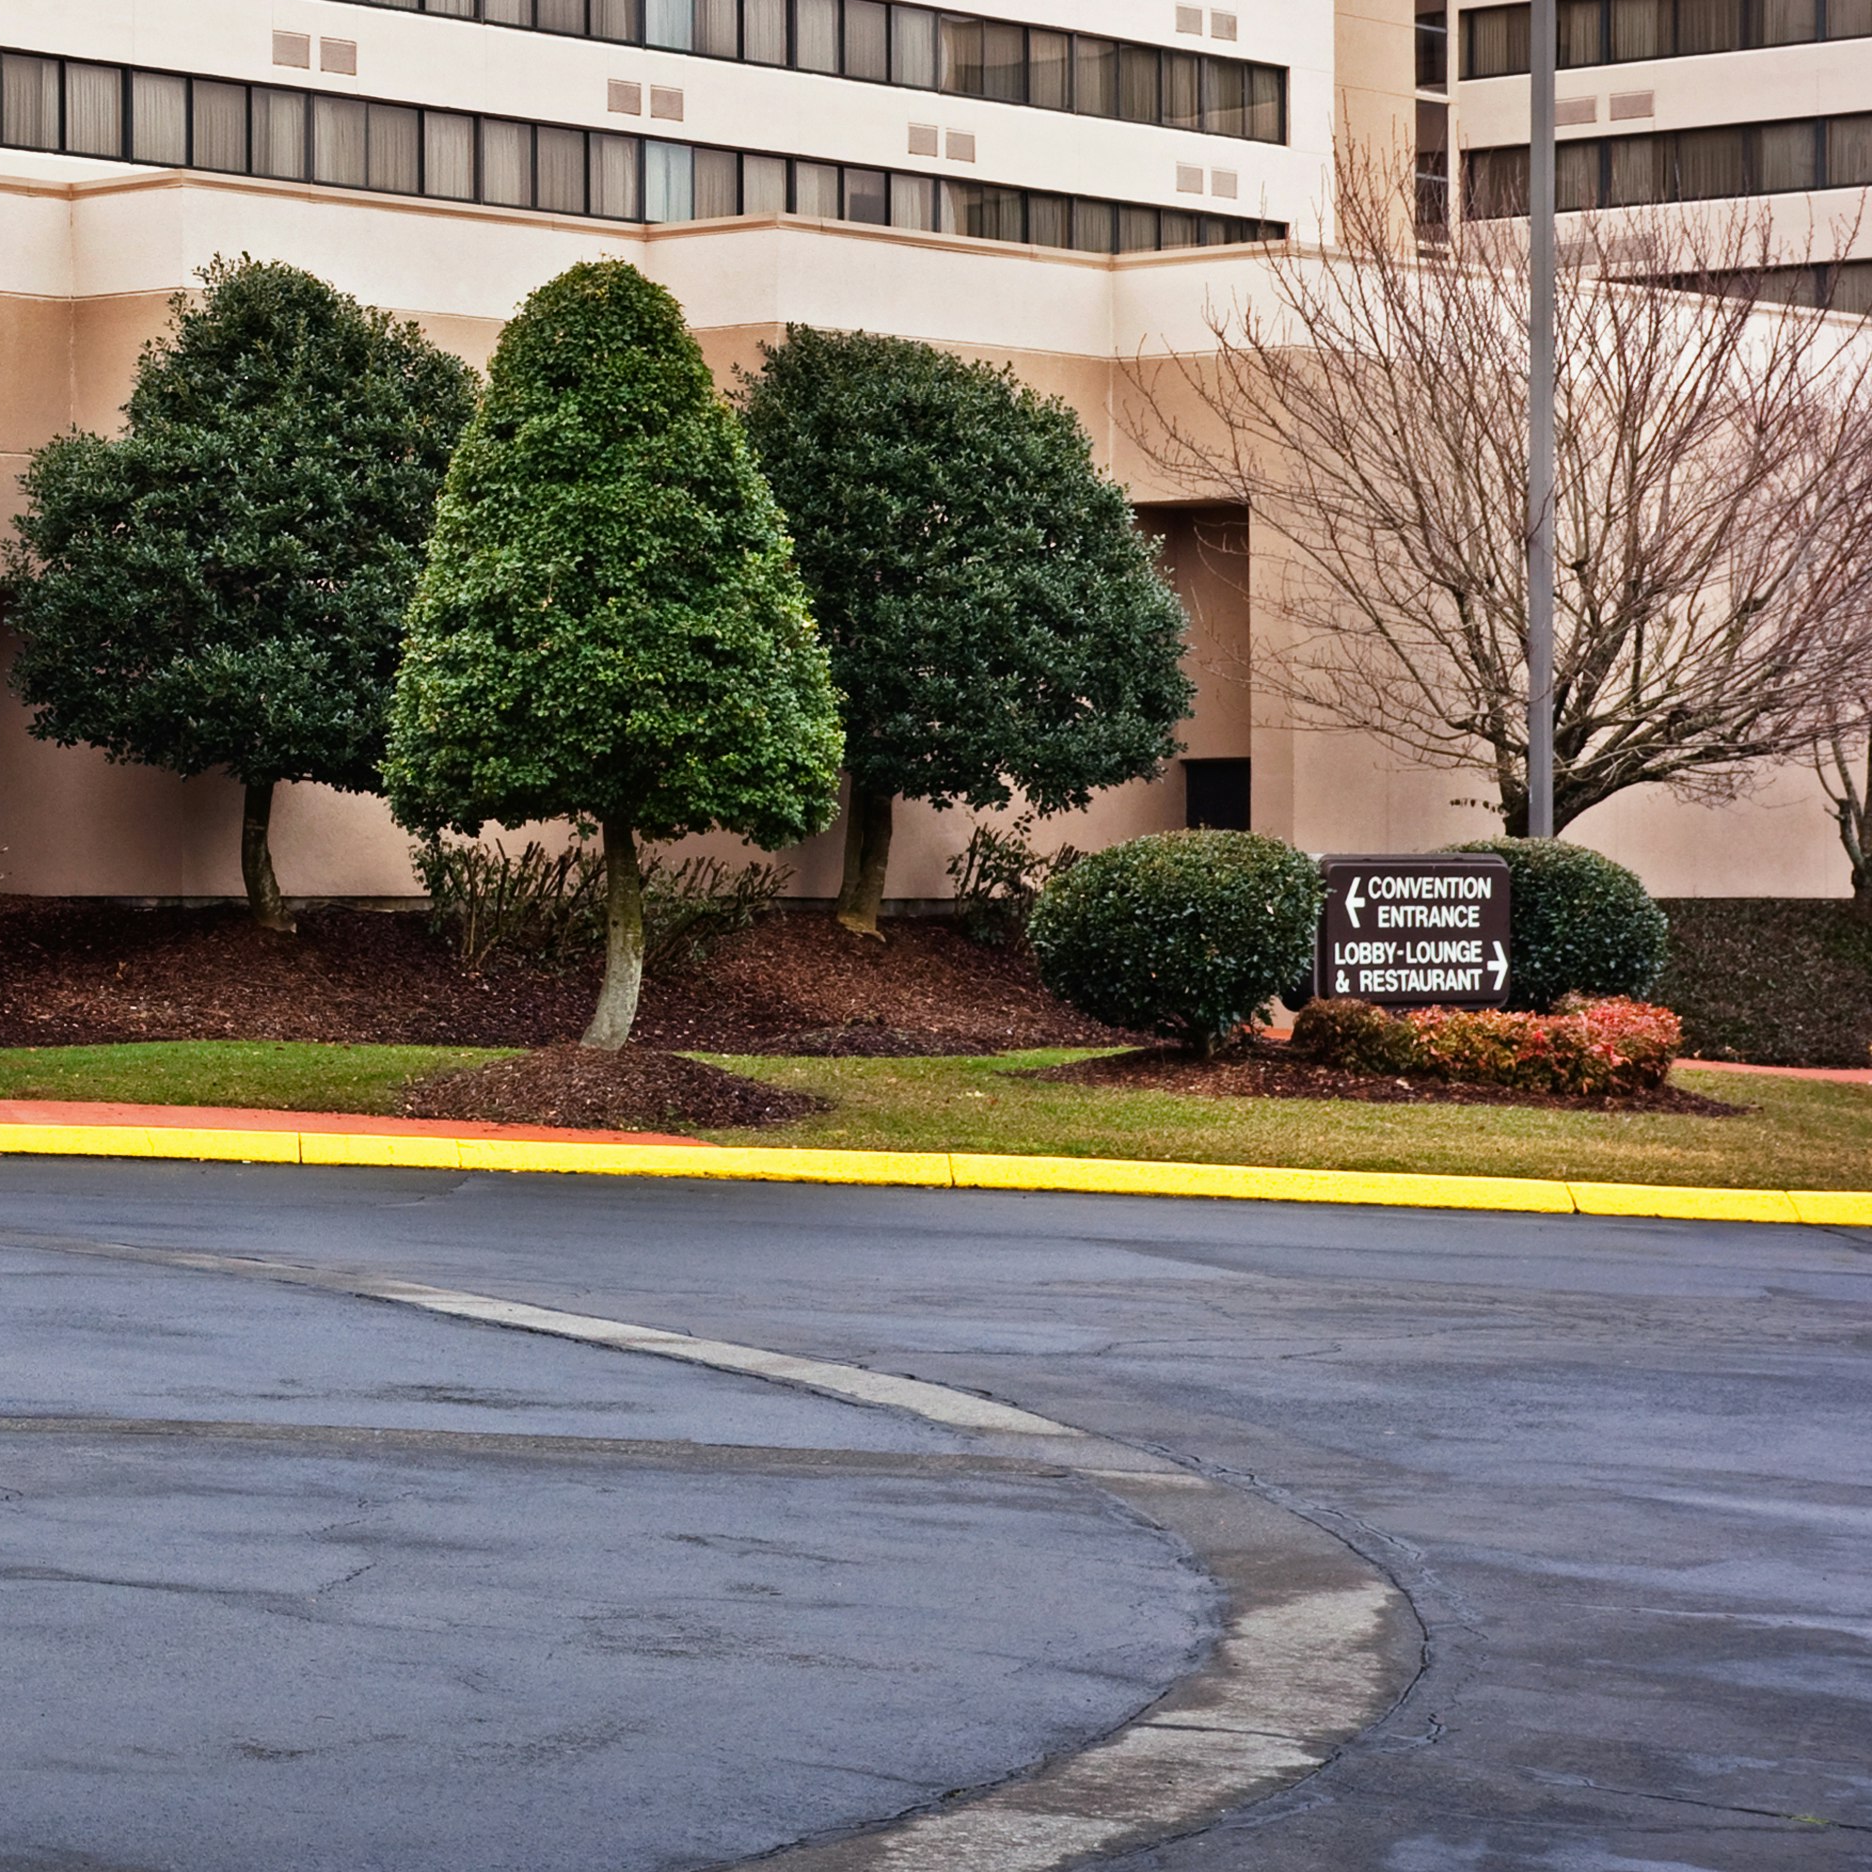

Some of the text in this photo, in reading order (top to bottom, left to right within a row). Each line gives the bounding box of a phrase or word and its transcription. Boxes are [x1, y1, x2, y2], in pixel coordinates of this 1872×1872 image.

[1367, 876, 1492, 899] CONVENTION
[1377, 905, 1480, 928] ENTRANCE
[1334, 940, 1483, 965] LOBBY-LOUNGE
[1335, 969, 1483, 993] & RESTAURANT
